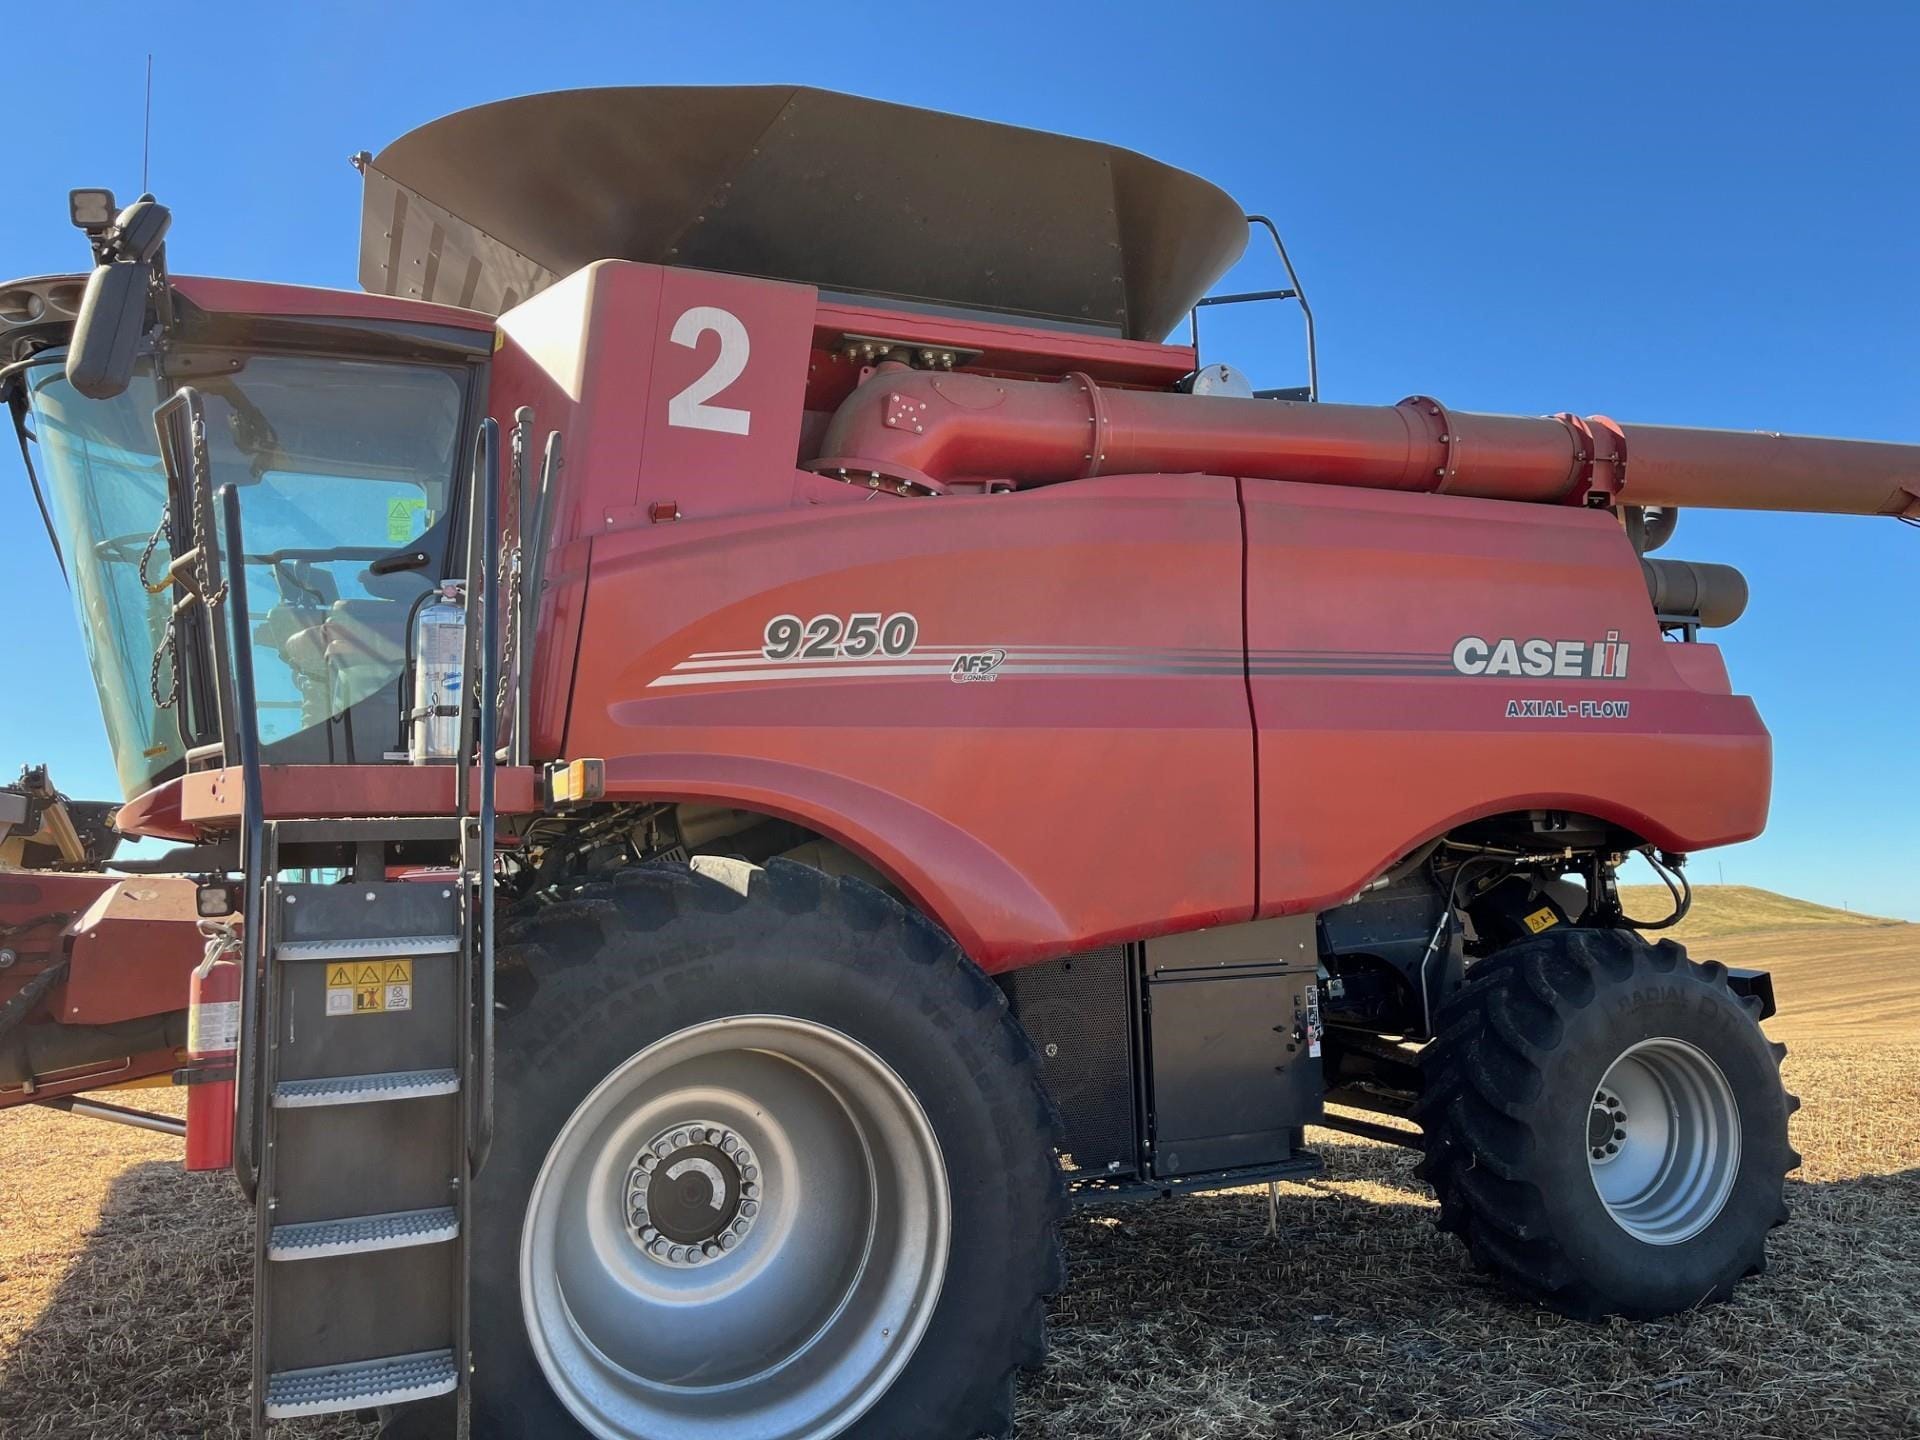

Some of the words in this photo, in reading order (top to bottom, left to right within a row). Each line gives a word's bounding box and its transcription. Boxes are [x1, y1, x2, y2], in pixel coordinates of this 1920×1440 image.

[668, 306, 751, 436] 2
[762, 612, 919, 661] 9250
[1453, 636, 1585, 677] CASE
[951, 654, 995, 674] AFS
[1505, 700, 1630, 718] AXIAL-FLOW
